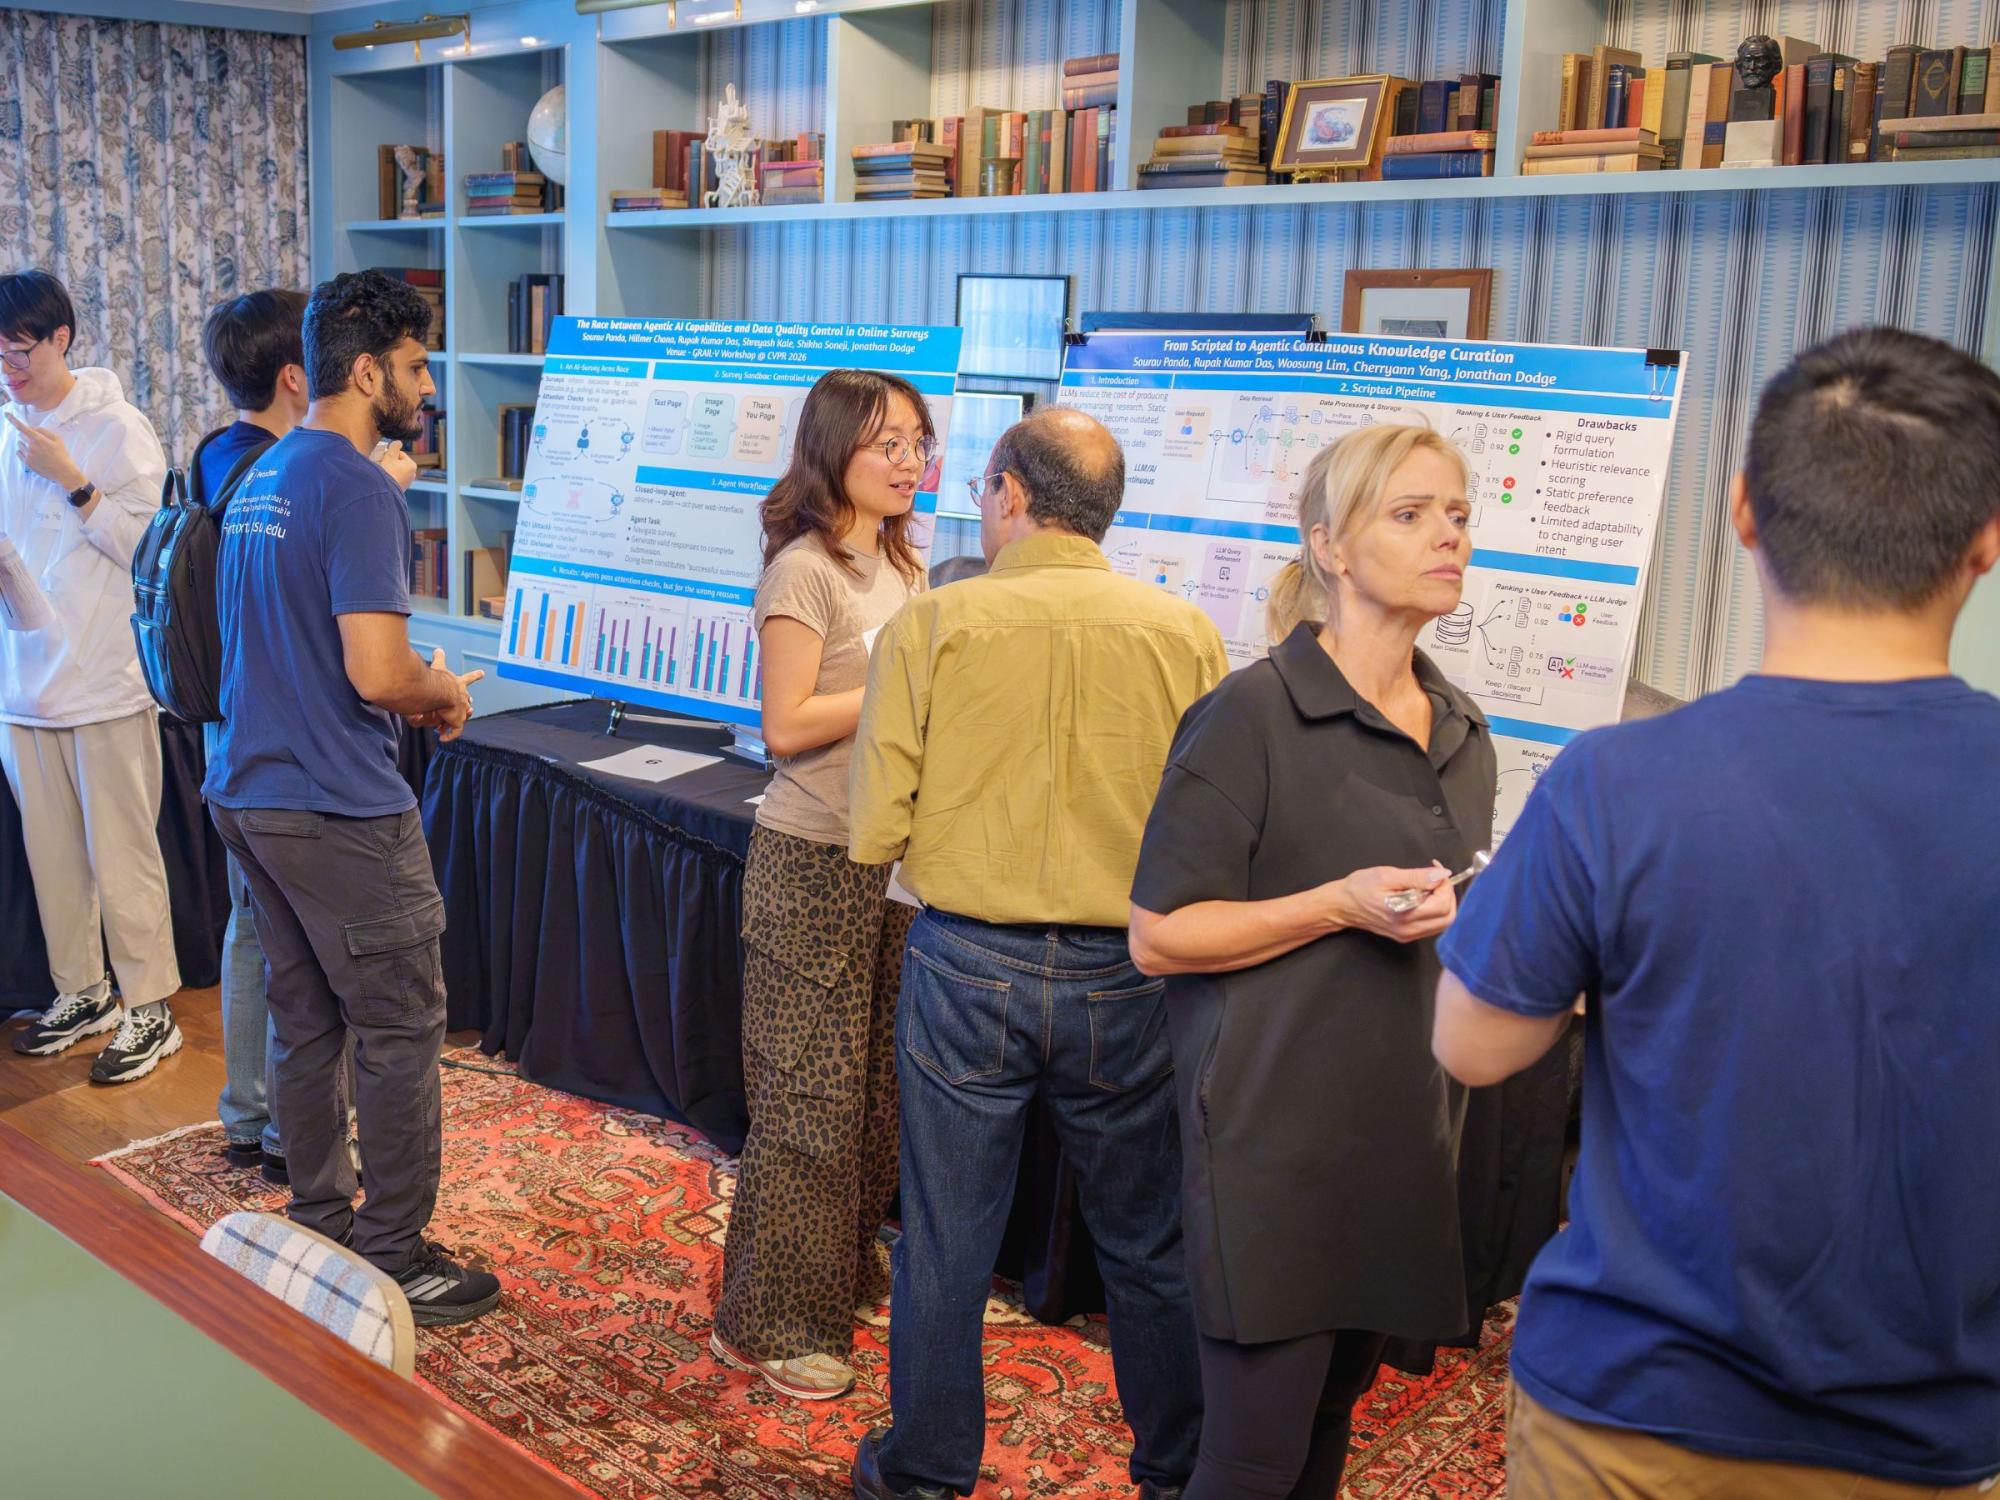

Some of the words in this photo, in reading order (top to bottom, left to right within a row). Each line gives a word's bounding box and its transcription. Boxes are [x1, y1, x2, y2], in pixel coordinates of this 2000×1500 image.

[577, 319, 590, 329] The
[592, 320, 609, 330] Race
[610, 320, 642, 331] between
[644, 321, 673, 333] Agentic
[675, 322, 683, 332] AI
[685, 322, 732, 334] Capabilities
[734, 323, 750, 333] and
[752, 324, 773, 334] Data
[775, 324, 809, 337] Quality
[811, 325, 844, 337] Control
[846, 326, 855, 337] in
[858, 326, 888, 338] Online
[890, 327, 929, 341] Surveys
[678, 335, 699, 346] Rupak
[701, 336, 723, 345] Kumar
[725, 336, 741, 347] Das,
[742, 337, 775, 349] Shreyash
[797, 340, 823, 350] Shikha
[850, 341, 888, 353] Jonathan
[890, 343, 916, 354] Dodge
[666, 347, 687, 357] Venue
[722, 350, 755, 360] Workshop
[757, 352, 766, 361] @
[767, 352, 787, 361] CVPR
[788, 353, 807, 362] 2026
[1164, 340, 1189, 352] From
[1191, 338, 1233, 354] Scripted
[1236, 340, 1247, 352] to
[1248, 339, 1290, 355] Agentic
[1293, 340, 1364, 355] Continuous
[1368, 343, 1447, 362] Knowledge
[1450, 347, 1515, 364] Curation
[722, 370, 743, 380] Survey
[773, 372, 806, 382] Controlled
[1133, 356, 1162, 367] Sourav
[1164, 357, 1192, 369] Panda,
[1194, 357, 1221, 370] Rupak
[1224, 358, 1253, 369] Kumar
[1255, 358, 1275, 370] Das,
[1278, 358, 1323, 372] Woosung
[1326, 359, 1350, 373] Lim,
[1354, 361, 1415, 377] Cherryann
[1419, 364, 1452, 381] Yang,
[1454, 367, 1512, 382] Jonathan
[1515, 371, 1557, 387] Dodge
[1098, 376, 1140, 385] Introduction
[1102, 390, 1113, 399] the
[1114, 391, 1127, 399] cost
[1128, 391, 1136, 399] of
[1136, 391, 1169, 402] producing
[1340, 382, 1350, 393] 2.
[1352, 383, 1393, 396] Scripted
[1395, 386, 1436, 399] Pipeline
[667, 399, 683, 409] Page
[704, 398, 724, 406] Image
[753, 401, 772, 410] Thank
[1147, 403, 1167, 413] Static
[1320, 399, 1334, 407] Data
[1334, 400, 1370, 410] Processing
[1377, 403, 1402, 413] Storage
[704, 407, 721, 416] Page
[746, 411, 758, 419] You
[760, 412, 776, 421] Page
[1456, 408, 1485, 418] Ranking
[1492, 411, 1508, 419] User
[1508, 412, 1543, 422] Feedback
[1104, 414, 1129, 423] become
[1577, 418, 1638, 432] Drawbacks
[1144, 427, 1163, 437] keeps
[1556, 430, 1583, 444] Rigid
[1584, 434, 1615, 447] query
[1490, 443, 1505, 451] 0.92
[1552, 444, 1615, 459] formulation
[1134, 463, 1158, 473] LLM/AI
[1551, 459, 1598, 473] Heuristic
[1600, 463, 1651, 477] relevance
[718, 479, 737, 489] Agent
[1548, 474, 1587, 488] scoring
[1546, 486, 1576, 499] Static
[1577, 491, 1635, 505] preference
[283, 498, 291, 506] is
[1543, 500, 1591, 515] feedback
[630, 514, 647, 525] Agent
[1540, 515, 1580, 529] Limited
[1581, 519, 1644, 537] adaptability
[1538, 530, 1550, 540] to
[1552, 531, 1599, 548] changing
[1600, 537, 1624, 548] user
[658, 538, 671, 547] valid
[671, 540, 700, 552] responses
[700, 543, 707, 551] to
[708, 544, 735, 556] complete
[1228, 547, 1242, 556] Query
[1536, 543, 1568, 556] intent
[1263, 553, 1277, 561] Data
[580, 569, 600, 581] Agents
[601, 573, 614, 582] pass
[614, 574, 641, 585] attention
[663, 581, 674, 590] but
[674, 582, 684, 593] for
[684, 583, 696, 593] the
[696, 586, 716, 599] wrong
[1496, 583, 1523, 593] Ranking
[1531, 587, 1548, 596] User
[1549, 590, 1582, 600] Feedback
[1589, 595, 1606, 604] LLM
[1606, 597, 1628, 607] Judge
[1537, 602, 1552, 610] 0.92
[1534, 618, 1549, 626] 0.92
[1444, 645, 1470, 655] Database
[1529, 652, 1544, 660] 0.75
[1526, 667, 1541, 676] 0.73
[1485, 679, 1503, 689] Keep
[1507, 682, 1532, 693] discard
[1491, 690, 1522, 700] decisions
[1522, 749, 1553, 761] Multi-Ag
